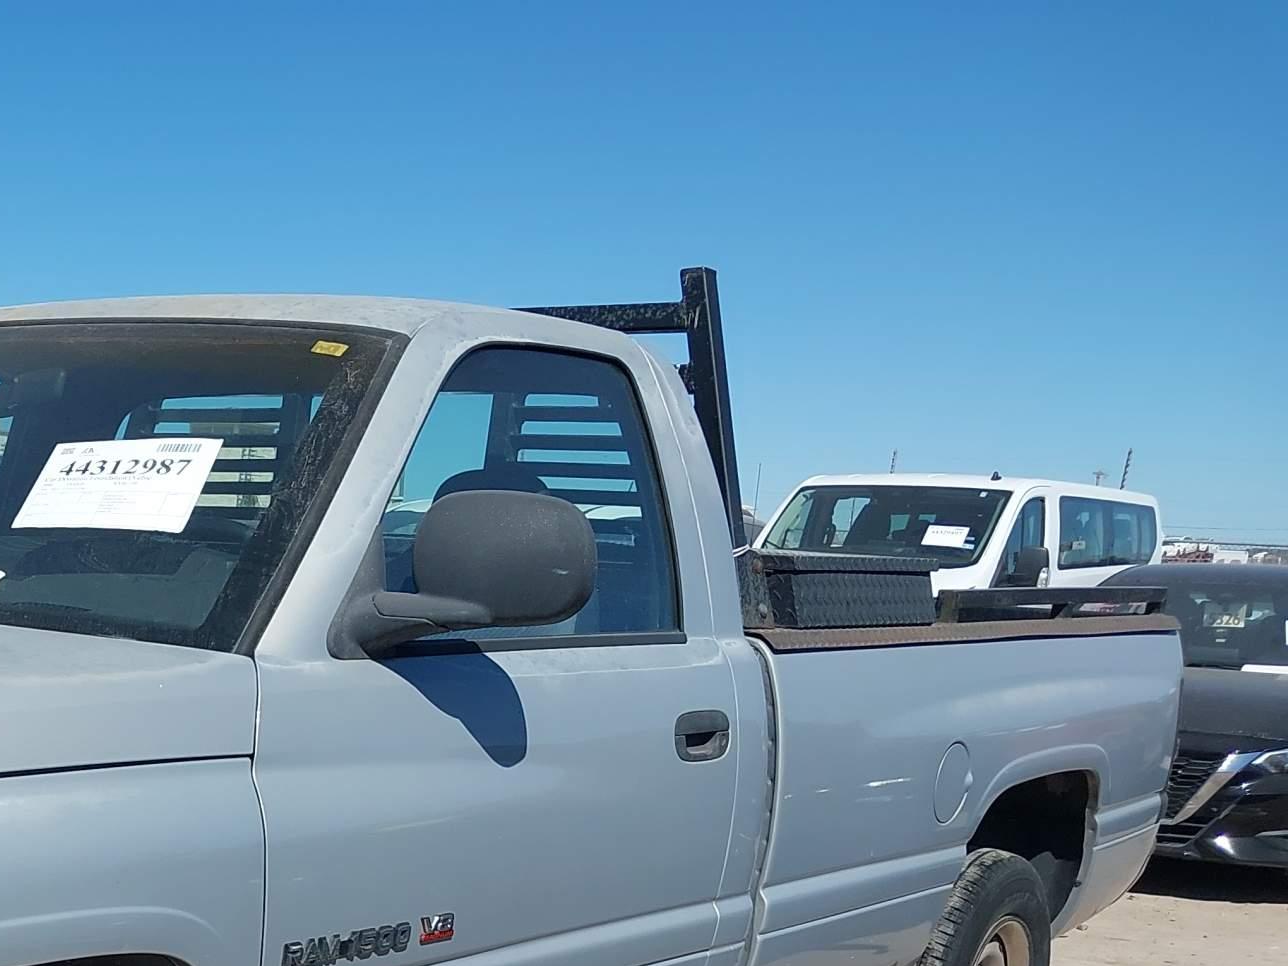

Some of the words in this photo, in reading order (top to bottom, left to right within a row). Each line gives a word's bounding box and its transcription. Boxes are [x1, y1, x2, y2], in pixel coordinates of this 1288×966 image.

[59, 458, 193, 476] 44312987
[420, 912, 455, 933] V8
[343, 922, 412, 962] 1500
